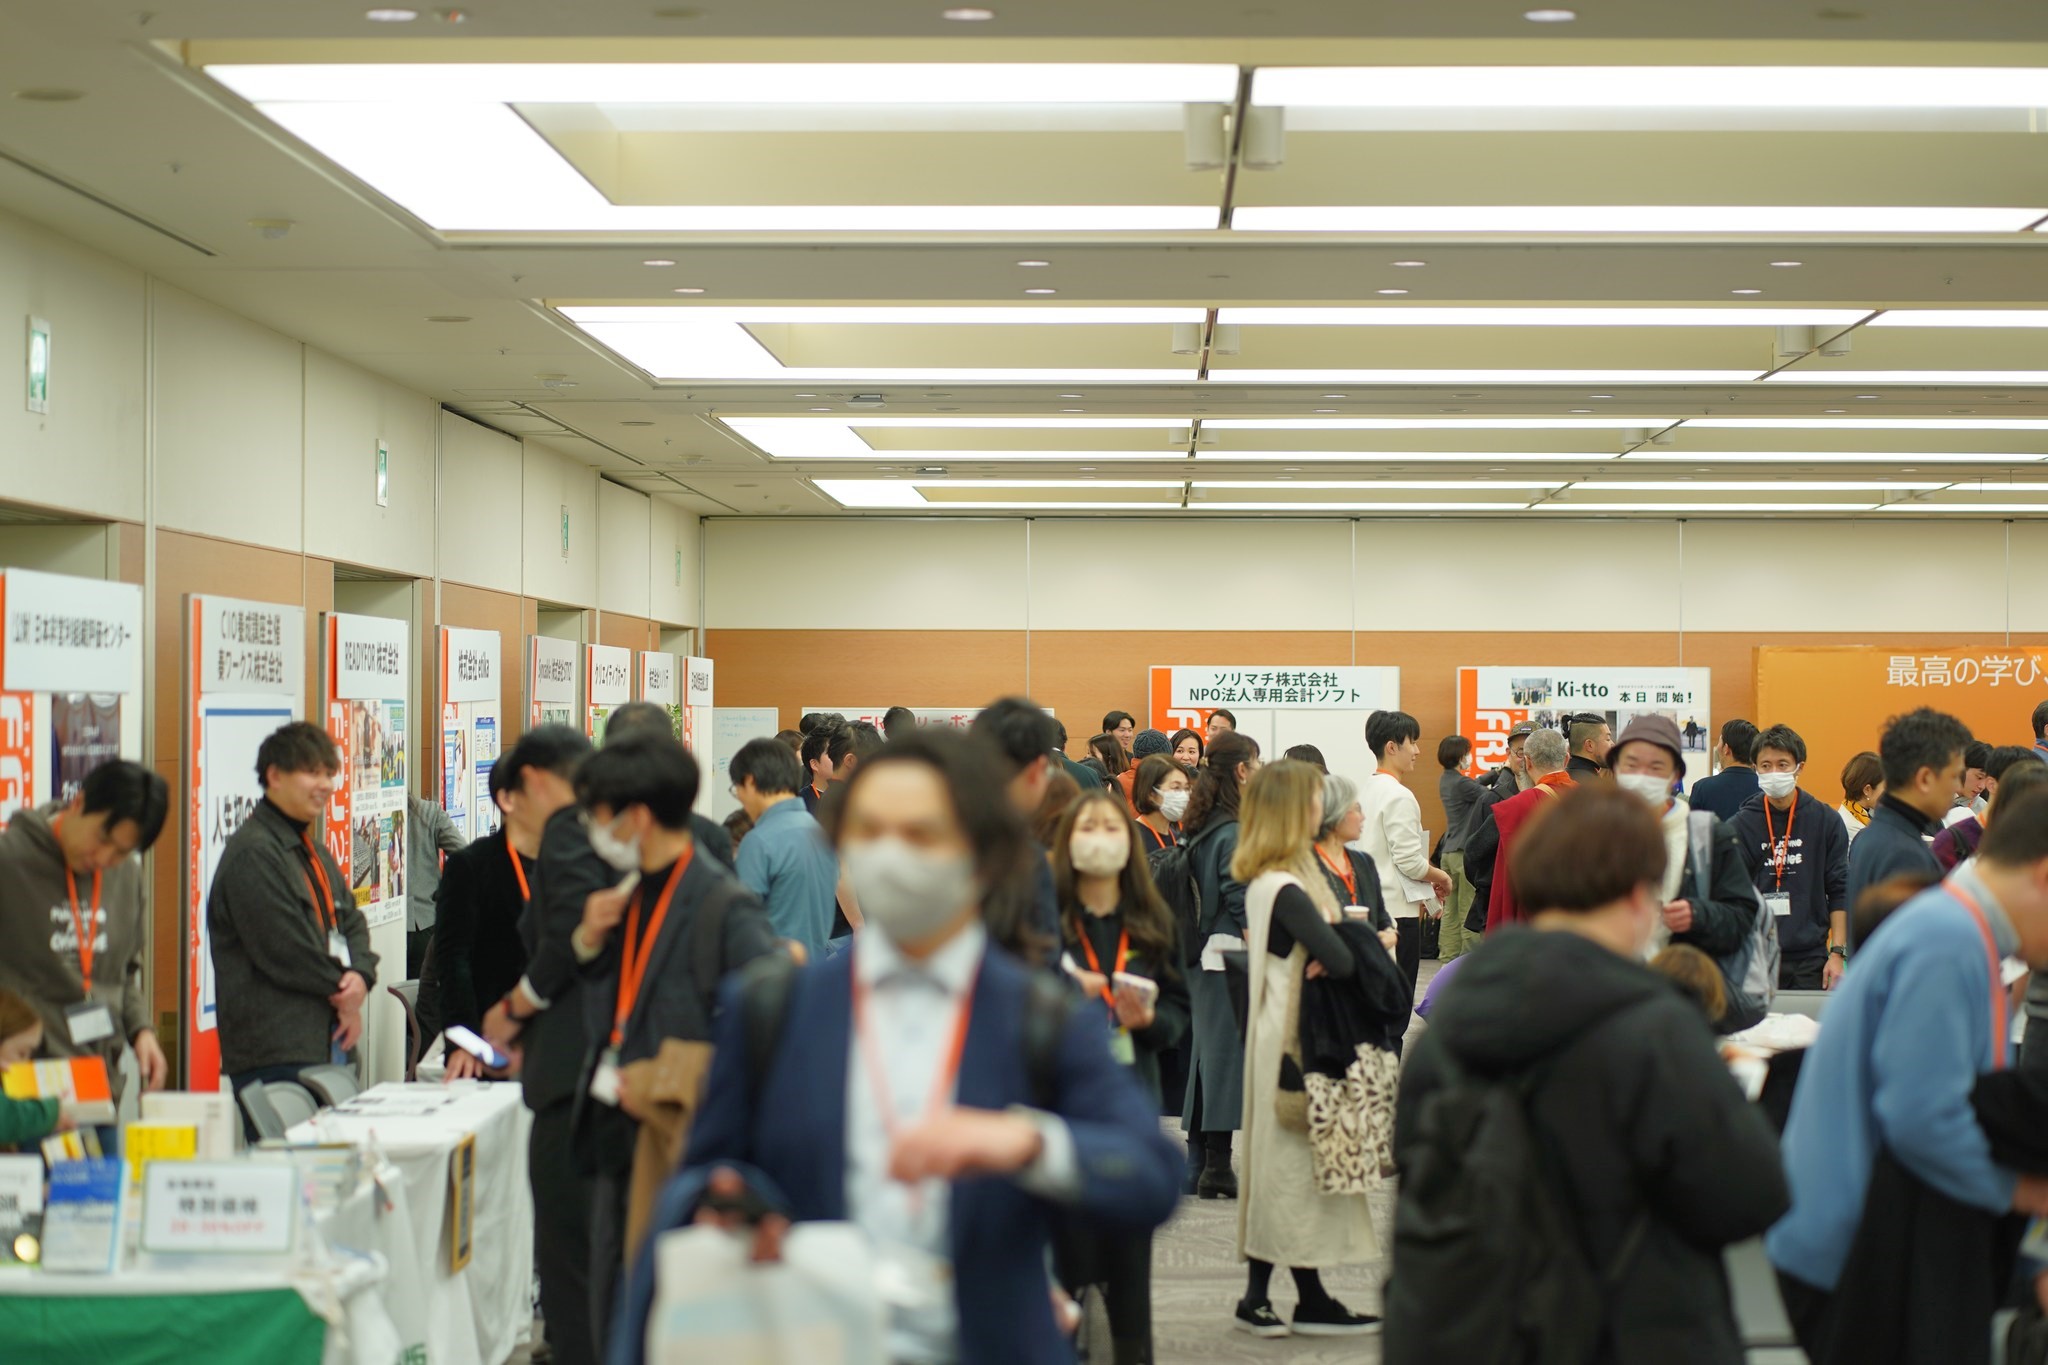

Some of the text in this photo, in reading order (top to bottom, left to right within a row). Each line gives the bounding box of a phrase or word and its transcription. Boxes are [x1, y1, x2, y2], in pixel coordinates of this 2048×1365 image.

[345, 641, 399, 675] READYFOR 株式会社
[458, 649, 478, 682] 株式会社
[1213, 672, 1339, 688] ソリマチ株式会社
[1189, 687, 1361, 704] NPO法人専用会計ソフト
[1557, 680, 1609, 698] Ki-tto
[1619, 691, 1646, 703] 本日
